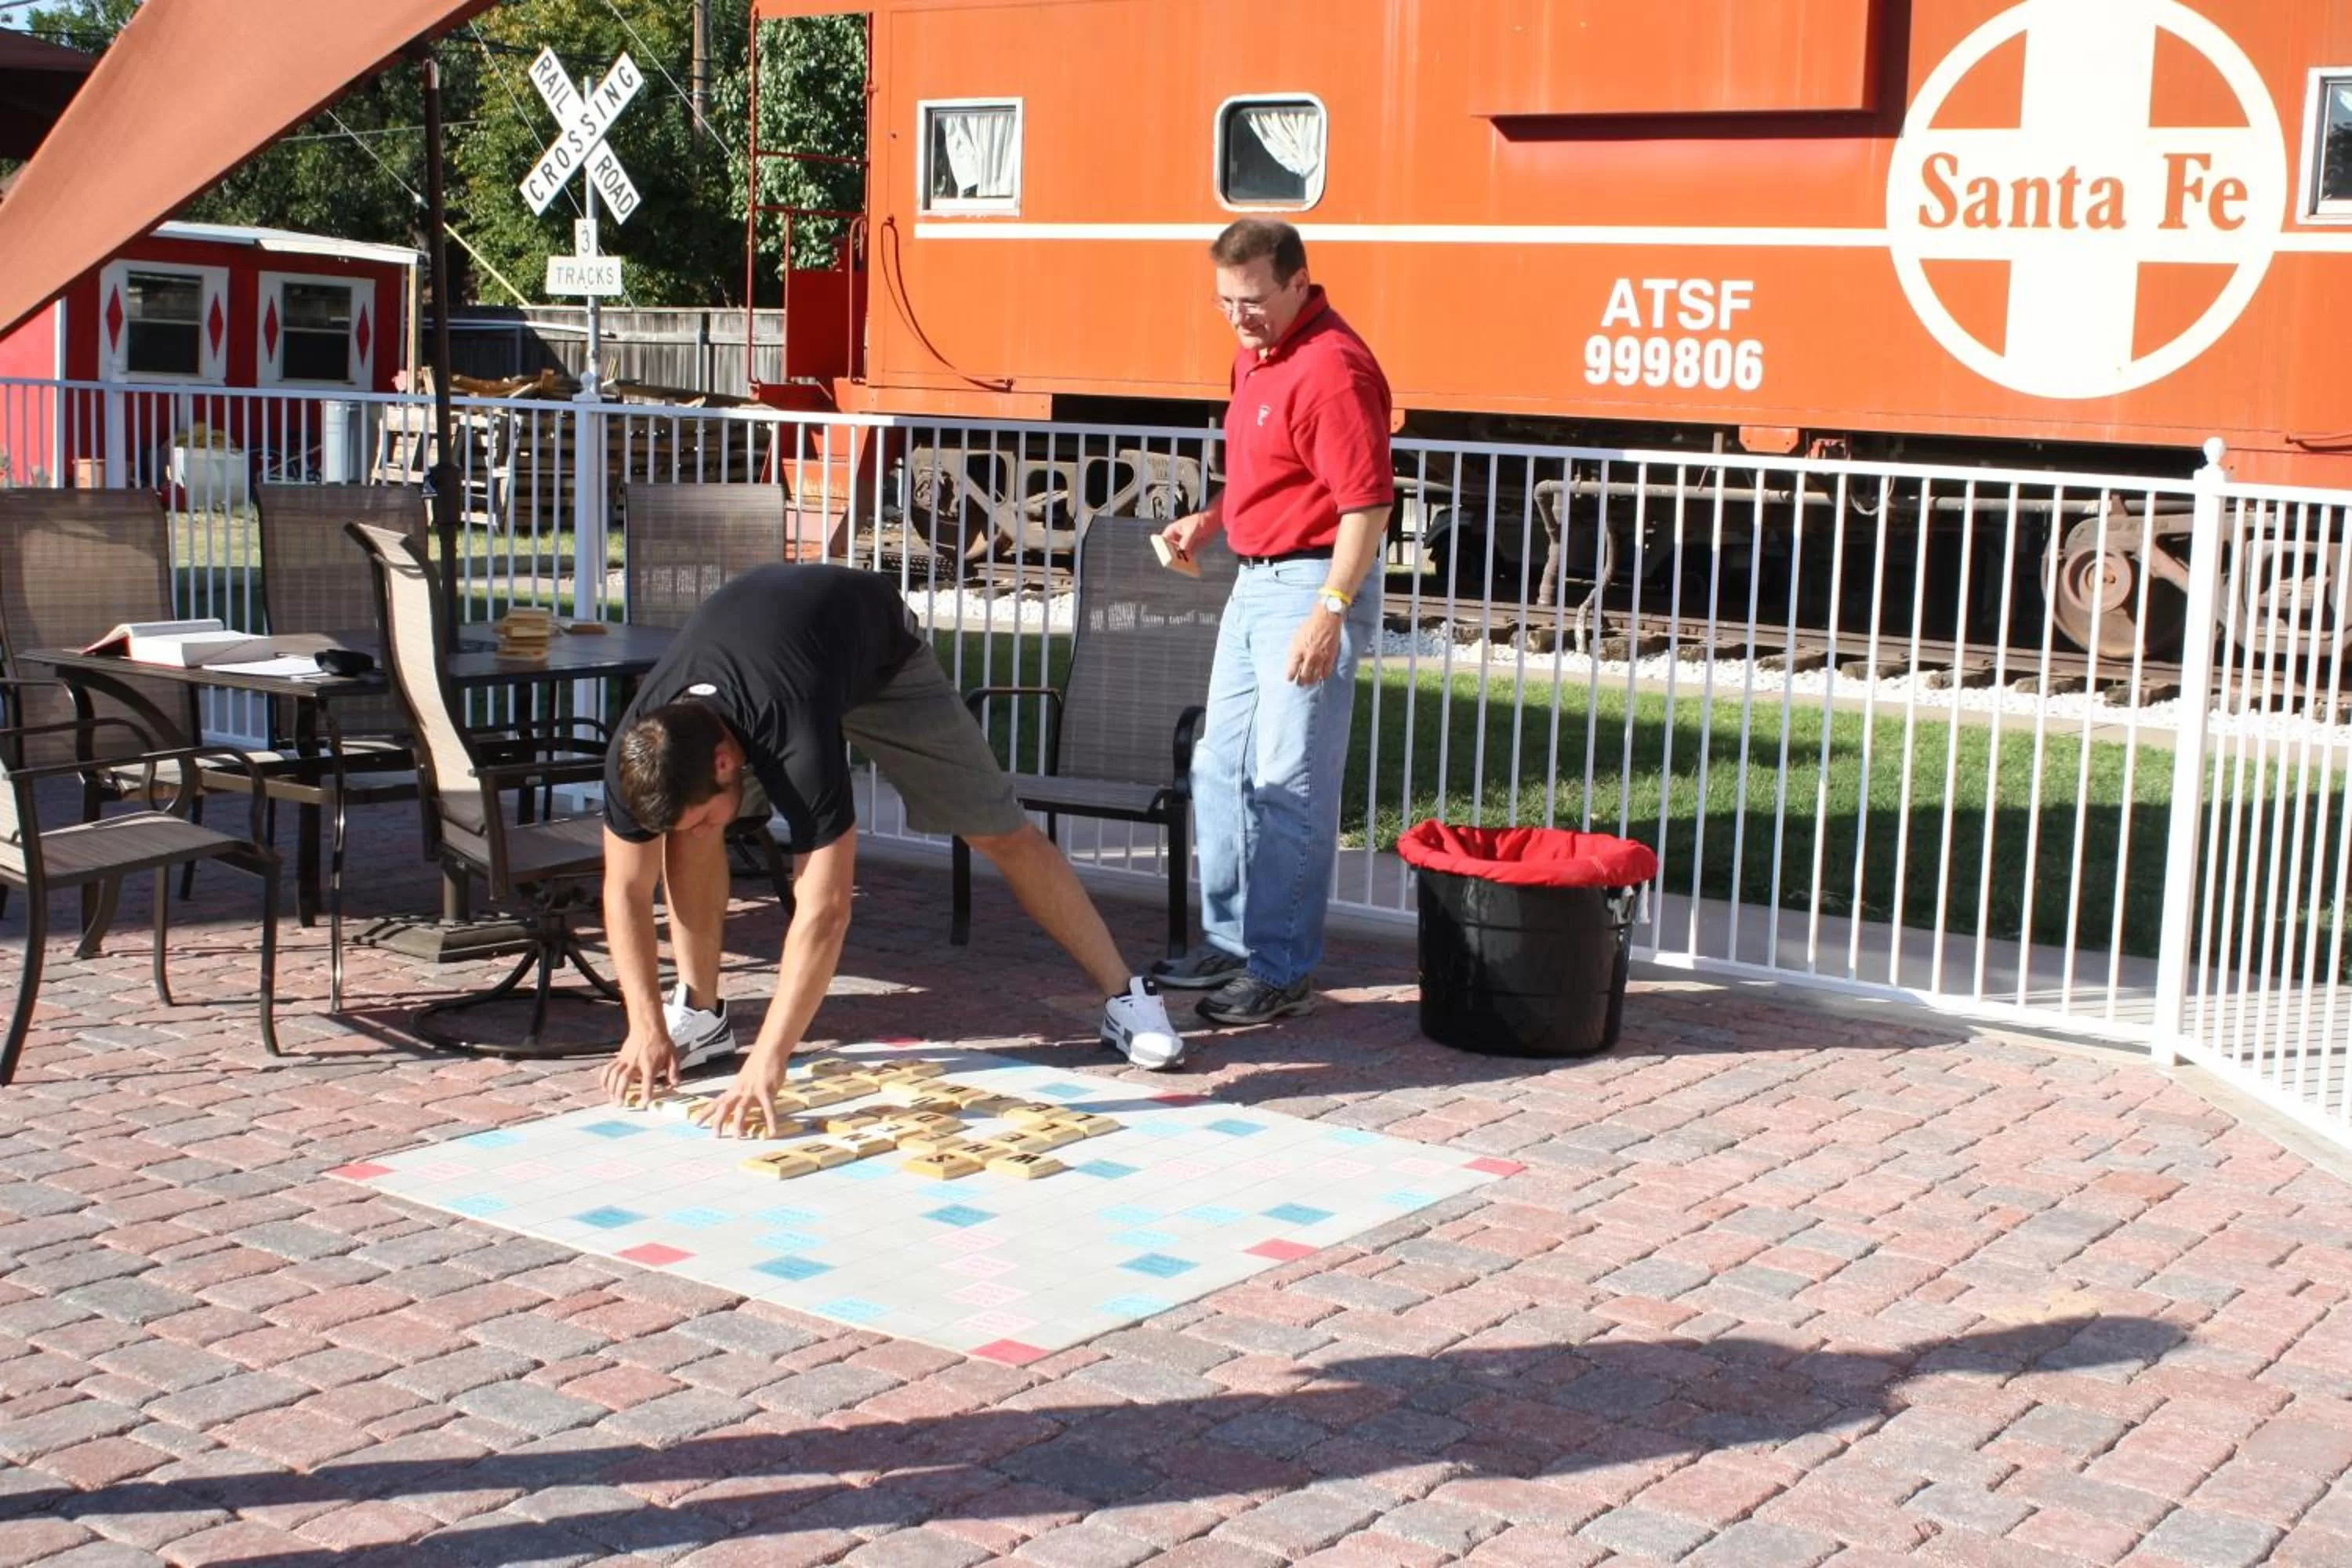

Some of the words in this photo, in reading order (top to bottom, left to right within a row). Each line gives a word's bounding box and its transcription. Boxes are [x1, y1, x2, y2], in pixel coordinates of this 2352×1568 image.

[528, 65, 635, 202] CROSSING
[533, 55, 571, 115] RAIL
[593, 154, 635, 216] ROAD
[1918, 151, 2127, 230] Santa
[2157, 152, 2248, 232] Fe
[581, 228, 590, 253] 3
[555, 266, 615, 285] TRACKS
[1601, 278, 1754, 331] ATSF
[1584, 335, 1763, 391] 999806
